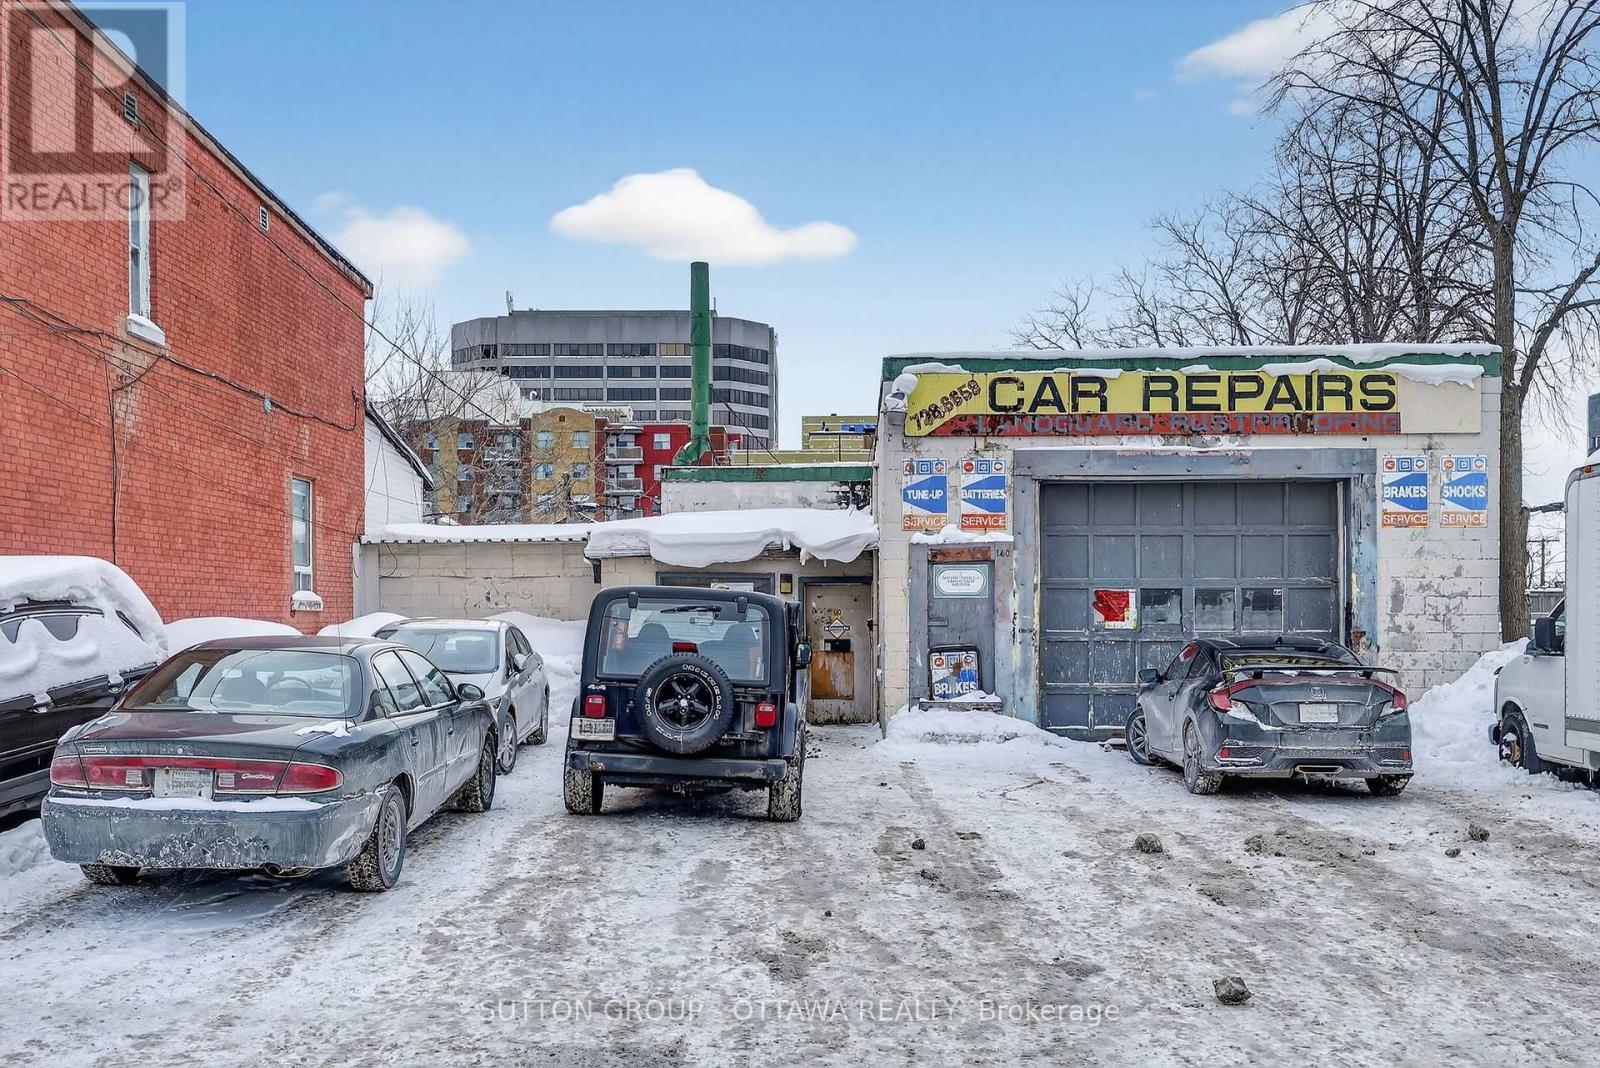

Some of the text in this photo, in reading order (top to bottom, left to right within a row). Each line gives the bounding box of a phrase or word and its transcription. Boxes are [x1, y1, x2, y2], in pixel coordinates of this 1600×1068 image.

[988, 374, 1396, 413] CAR REPAIRS
[906, 489, 944, 500] TUNE-UP
[961, 489, 1006, 499] BATTERIES
[1384, 485, 1427, 498] BRAKES
[1442, 485, 1486, 498] SHOCKS
[904, 516, 947, 527] SERVICE
[961, 516, 1007, 527] SERVICE
[1383, 514, 1428, 524] SERVICE
[1442, 514, 1487, 524] SERVICE
